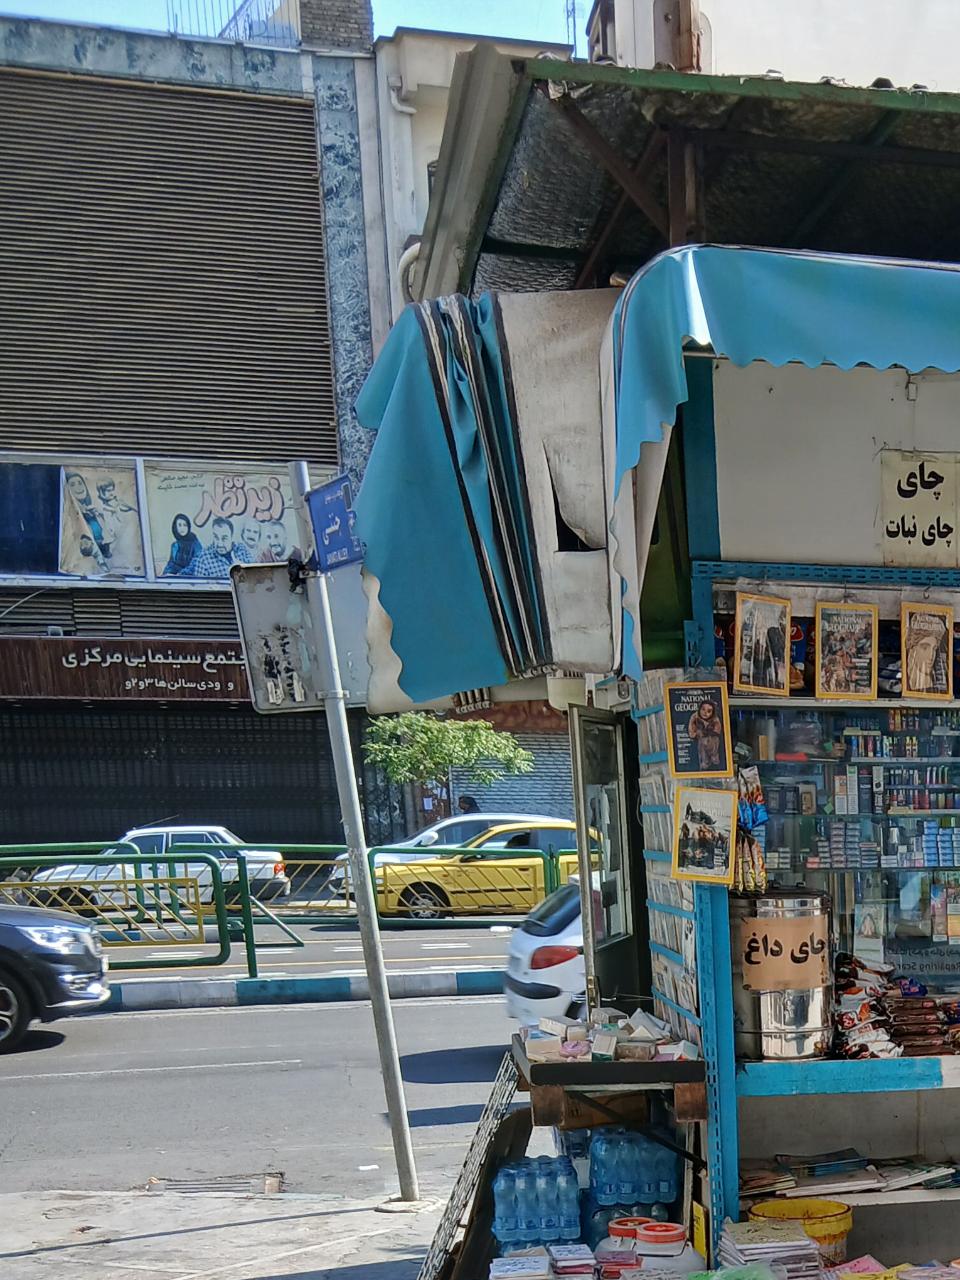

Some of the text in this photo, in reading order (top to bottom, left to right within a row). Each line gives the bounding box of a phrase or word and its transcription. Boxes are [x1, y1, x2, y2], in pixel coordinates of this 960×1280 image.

[897, 462, 945, 500] چای
[193, 475, 285, 528] زیر نظر
[885, 514, 918, 545] نبات
[922, 515, 954, 548] چای
[62, 648, 248, 672] جتمع سینمایی مرکزی
[680, 694, 712, 702] NATIONAL
[744, 931, 827, 965] چای داغ
